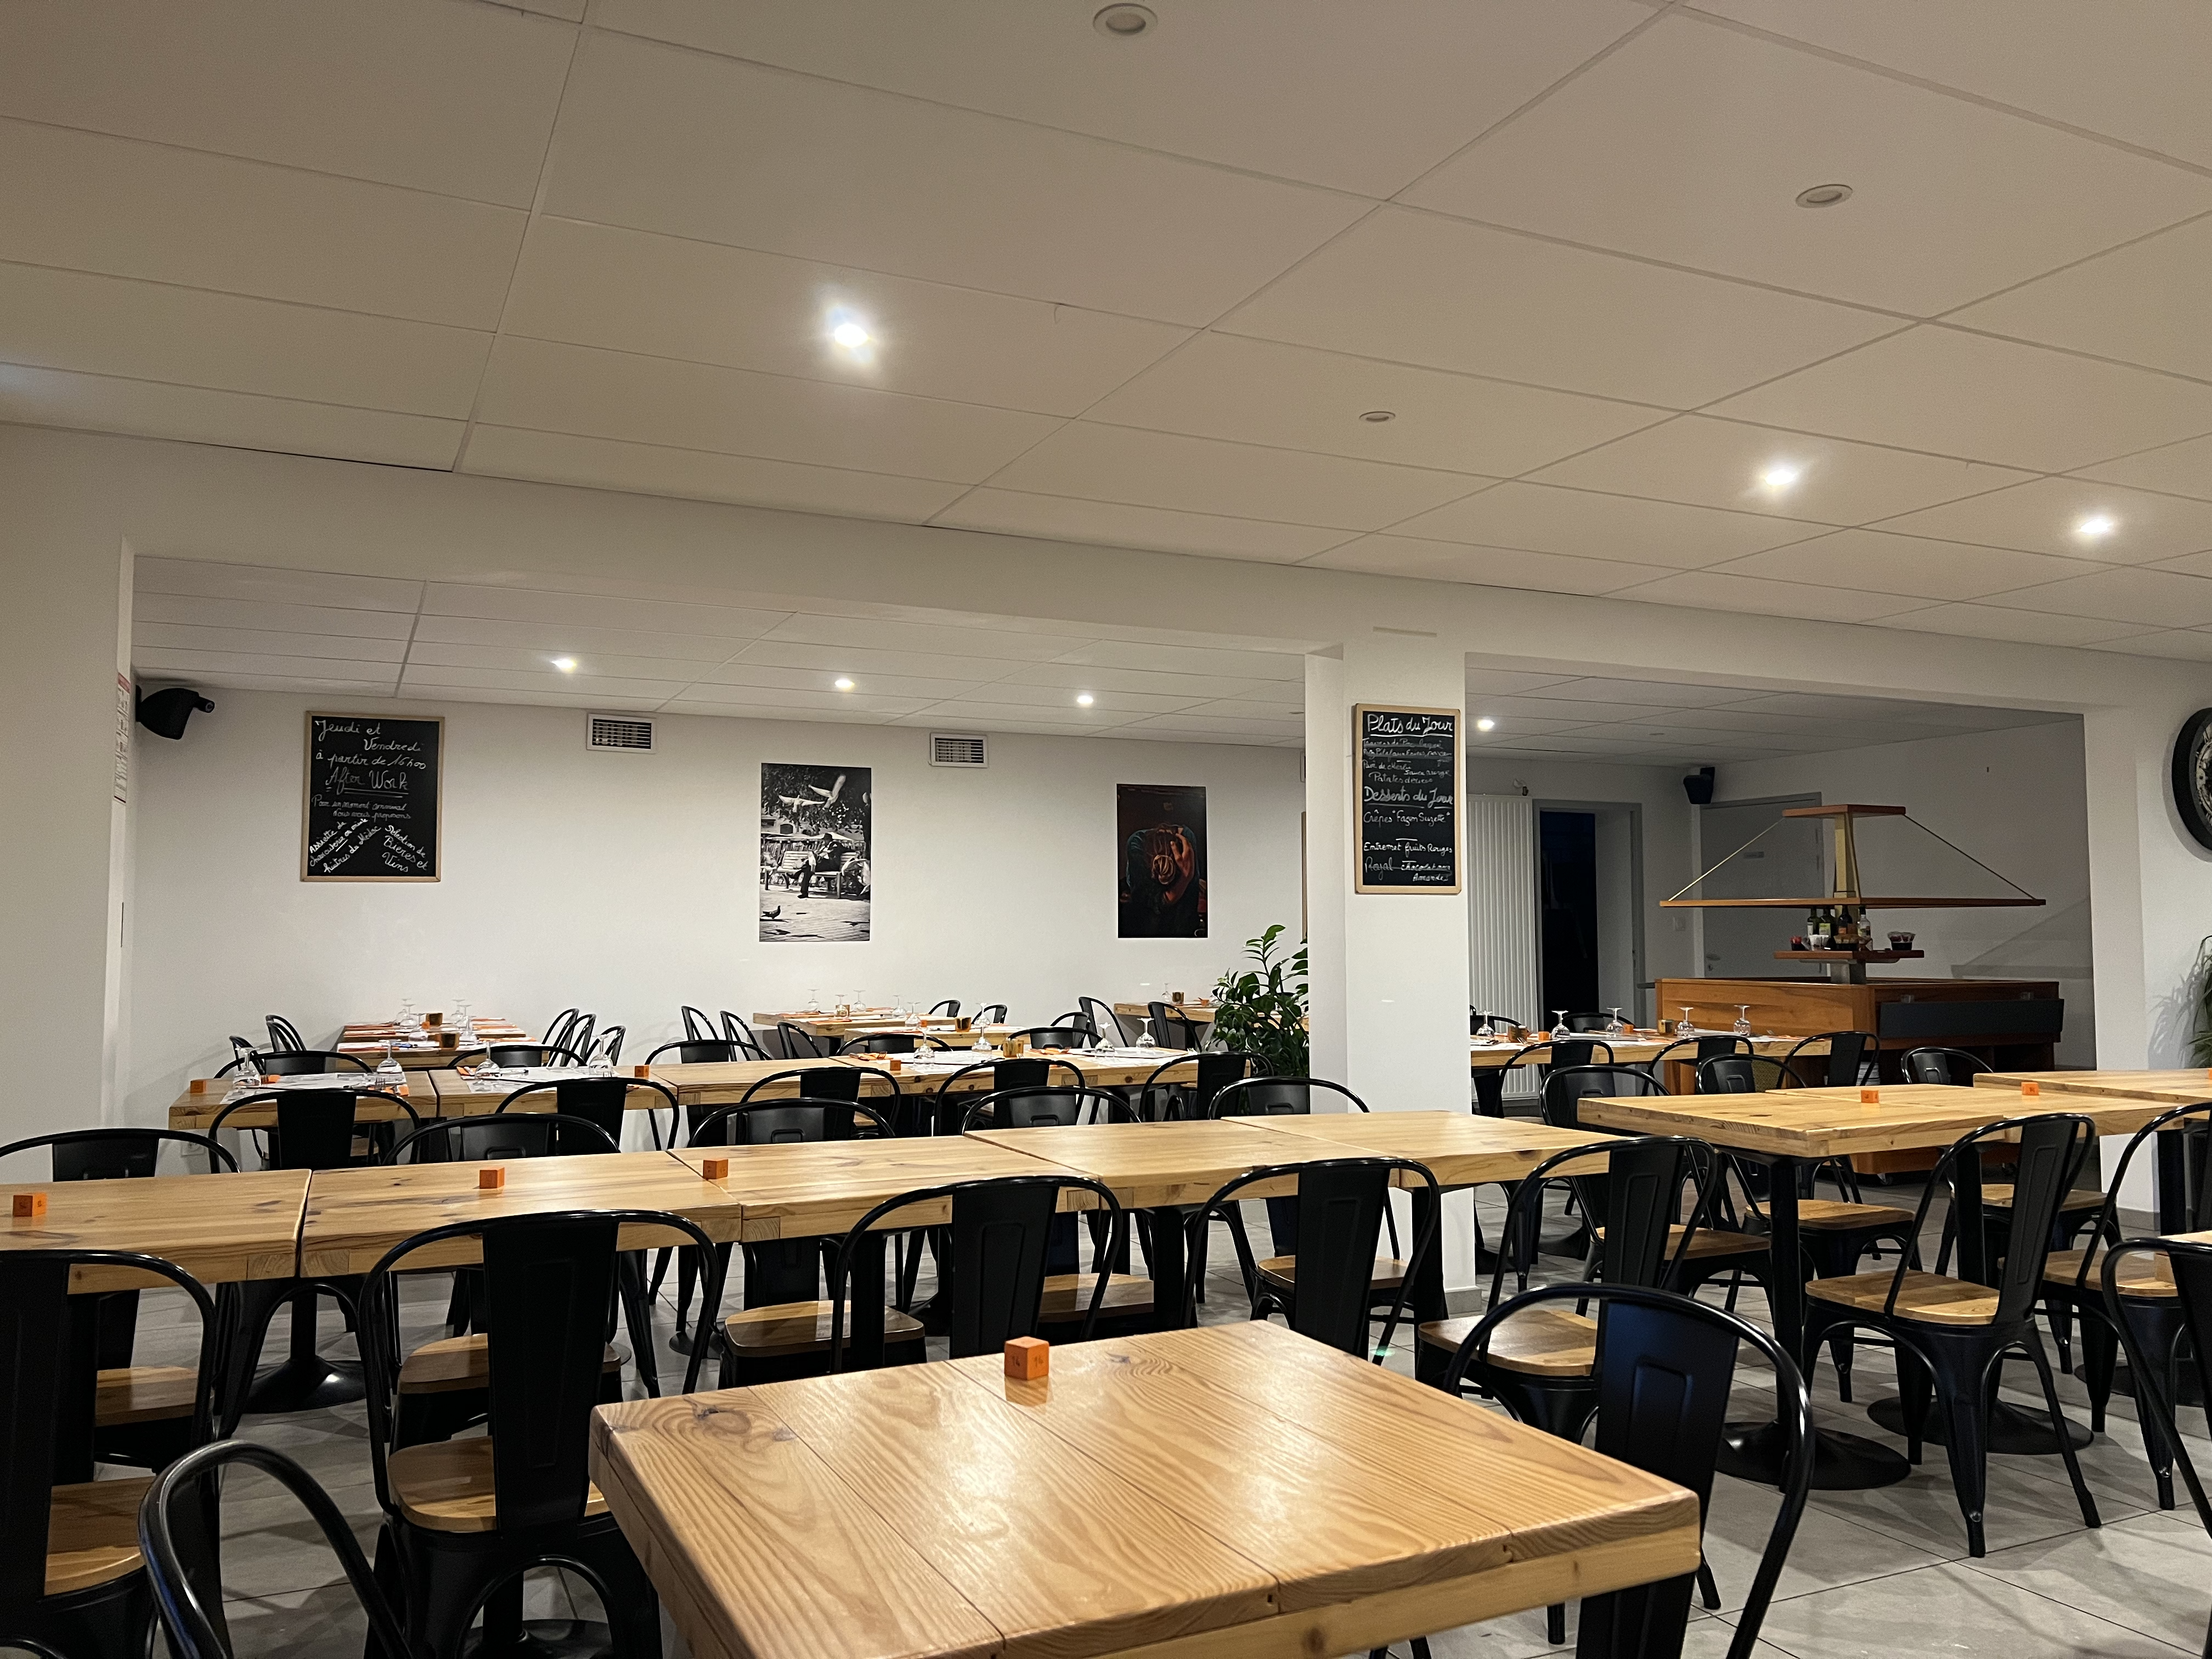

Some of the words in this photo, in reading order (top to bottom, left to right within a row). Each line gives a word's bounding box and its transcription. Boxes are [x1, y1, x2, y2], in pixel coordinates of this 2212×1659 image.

[315, 720, 360, 741] Jeudi
[366, 723, 381, 735] et
[1368, 714, 1403, 733] Plats
[1406, 717, 1420, 731] du
[1422, 716, 1453, 735] Jour
[363, 737, 425, 751] Vendredi
[316, 749, 323, 759] à
[328, 753, 369, 769] partir
[371, 756, 386, 765] de
[325, 766, 365, 795] After
[369, 770, 408, 790] Work
[1369, 771, 1403, 783] Patates
[1364, 786, 1410, 802] Desserts
[1413, 789, 1427, 800] du
[1427, 788, 1453, 808] Jour
[371, 812, 411, 822] proposons
[1363, 809, 1392, 827] Crêpes
[416, 847, 426, 858] de
[1427, 843, 1452, 856] Rouges
[382, 852, 408, 872] Vins
[417, 861, 428, 870] et
[1365, 856, 1393, 881] Royal
